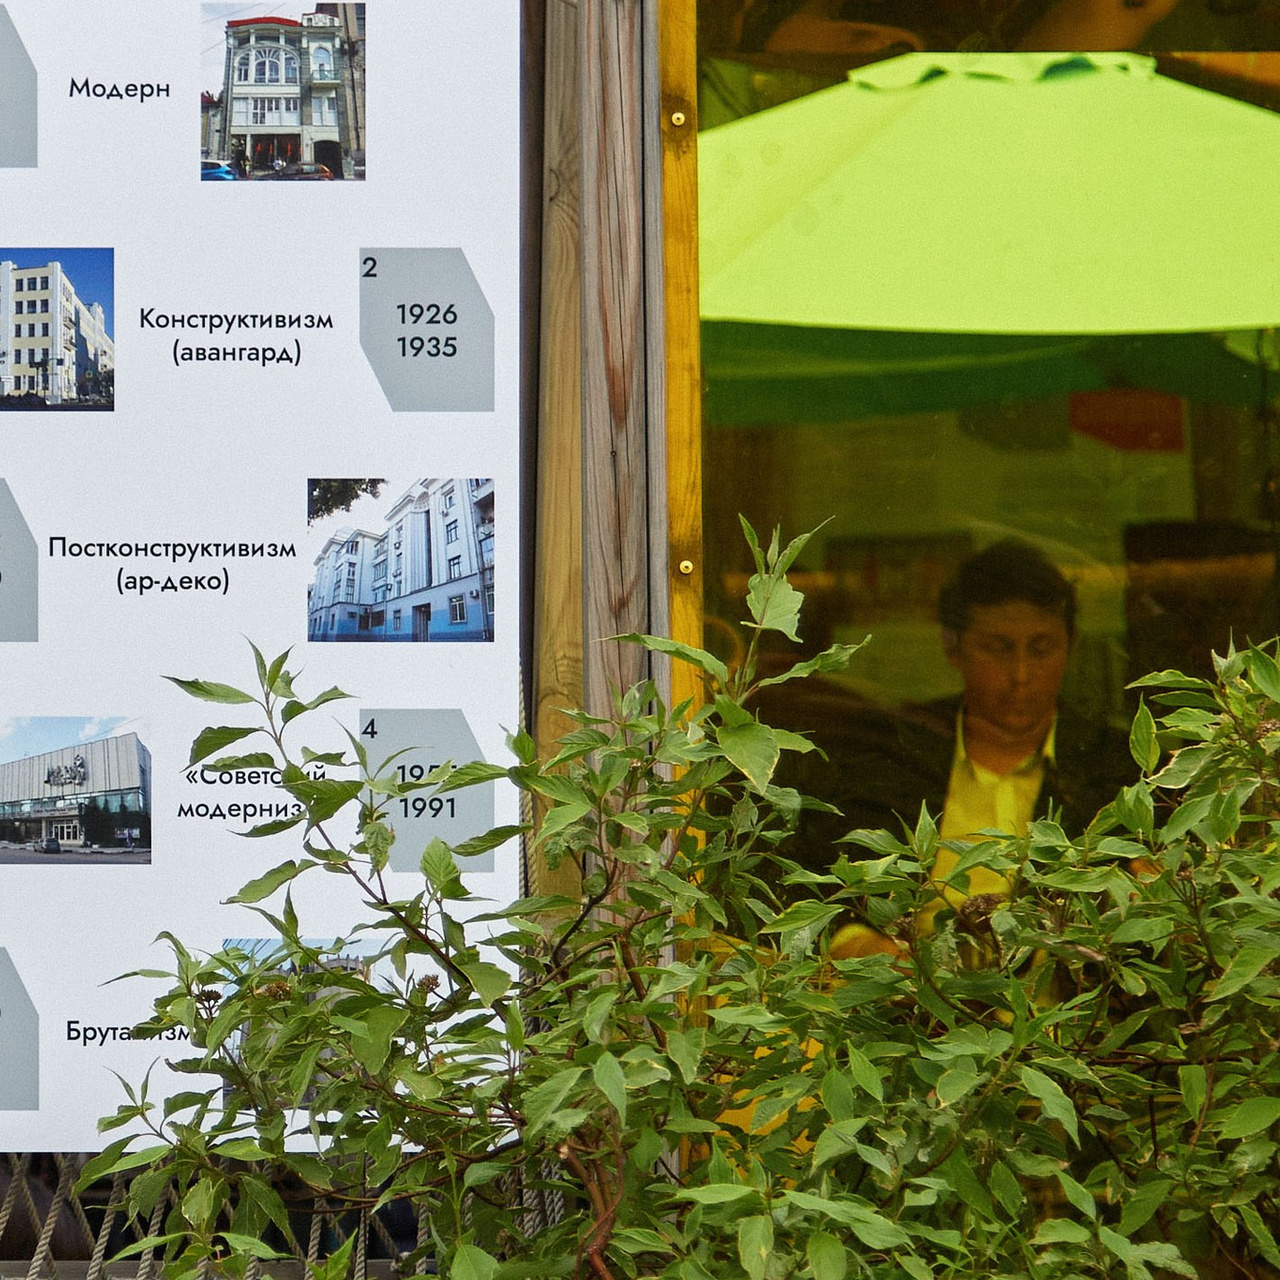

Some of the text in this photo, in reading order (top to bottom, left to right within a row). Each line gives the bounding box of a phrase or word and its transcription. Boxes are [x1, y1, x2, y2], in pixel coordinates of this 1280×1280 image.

[69, 77, 170, 104] Модерн
[362, 256, 378, 278] 2
[140, 307, 334, 335] Конструктивизм
[396, 303, 458, 325] 1926
[173, 338, 301, 367] (авангард)
[397, 336, 457, 358] 1935
[49, 536, 297, 563] Постконструктивизм
[117, 567, 229, 596] (ар-деко)
[361, 718, 378, 739] 4
[185, 764, 326, 786] «Советсй
[177, 802, 303, 823] модерниз
[399, 797, 455, 818] 1991
[66, 1020, 190, 1047] Брутазм
